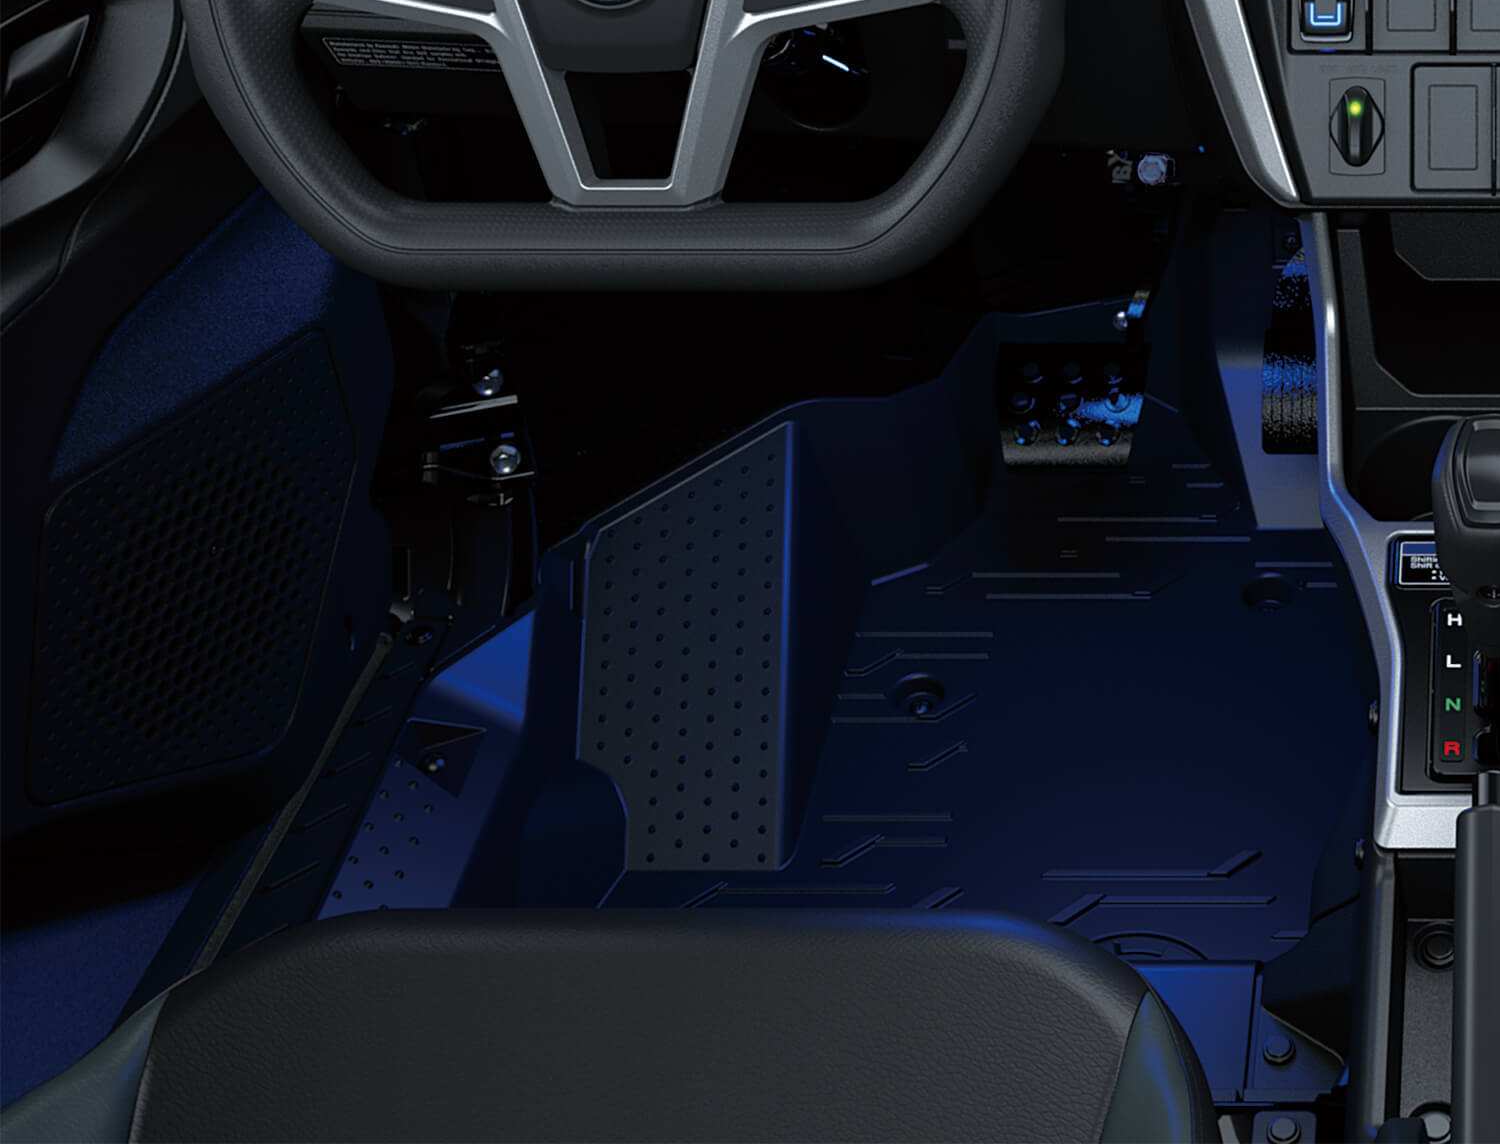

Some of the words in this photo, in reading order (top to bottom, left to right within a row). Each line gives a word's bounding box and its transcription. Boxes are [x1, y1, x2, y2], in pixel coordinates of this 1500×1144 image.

[1447, 613, 1463, 627] H
[1446, 654, 1462, 668] L
[1445, 697, 1461, 711] N
[1444, 741, 1460, 756] R
